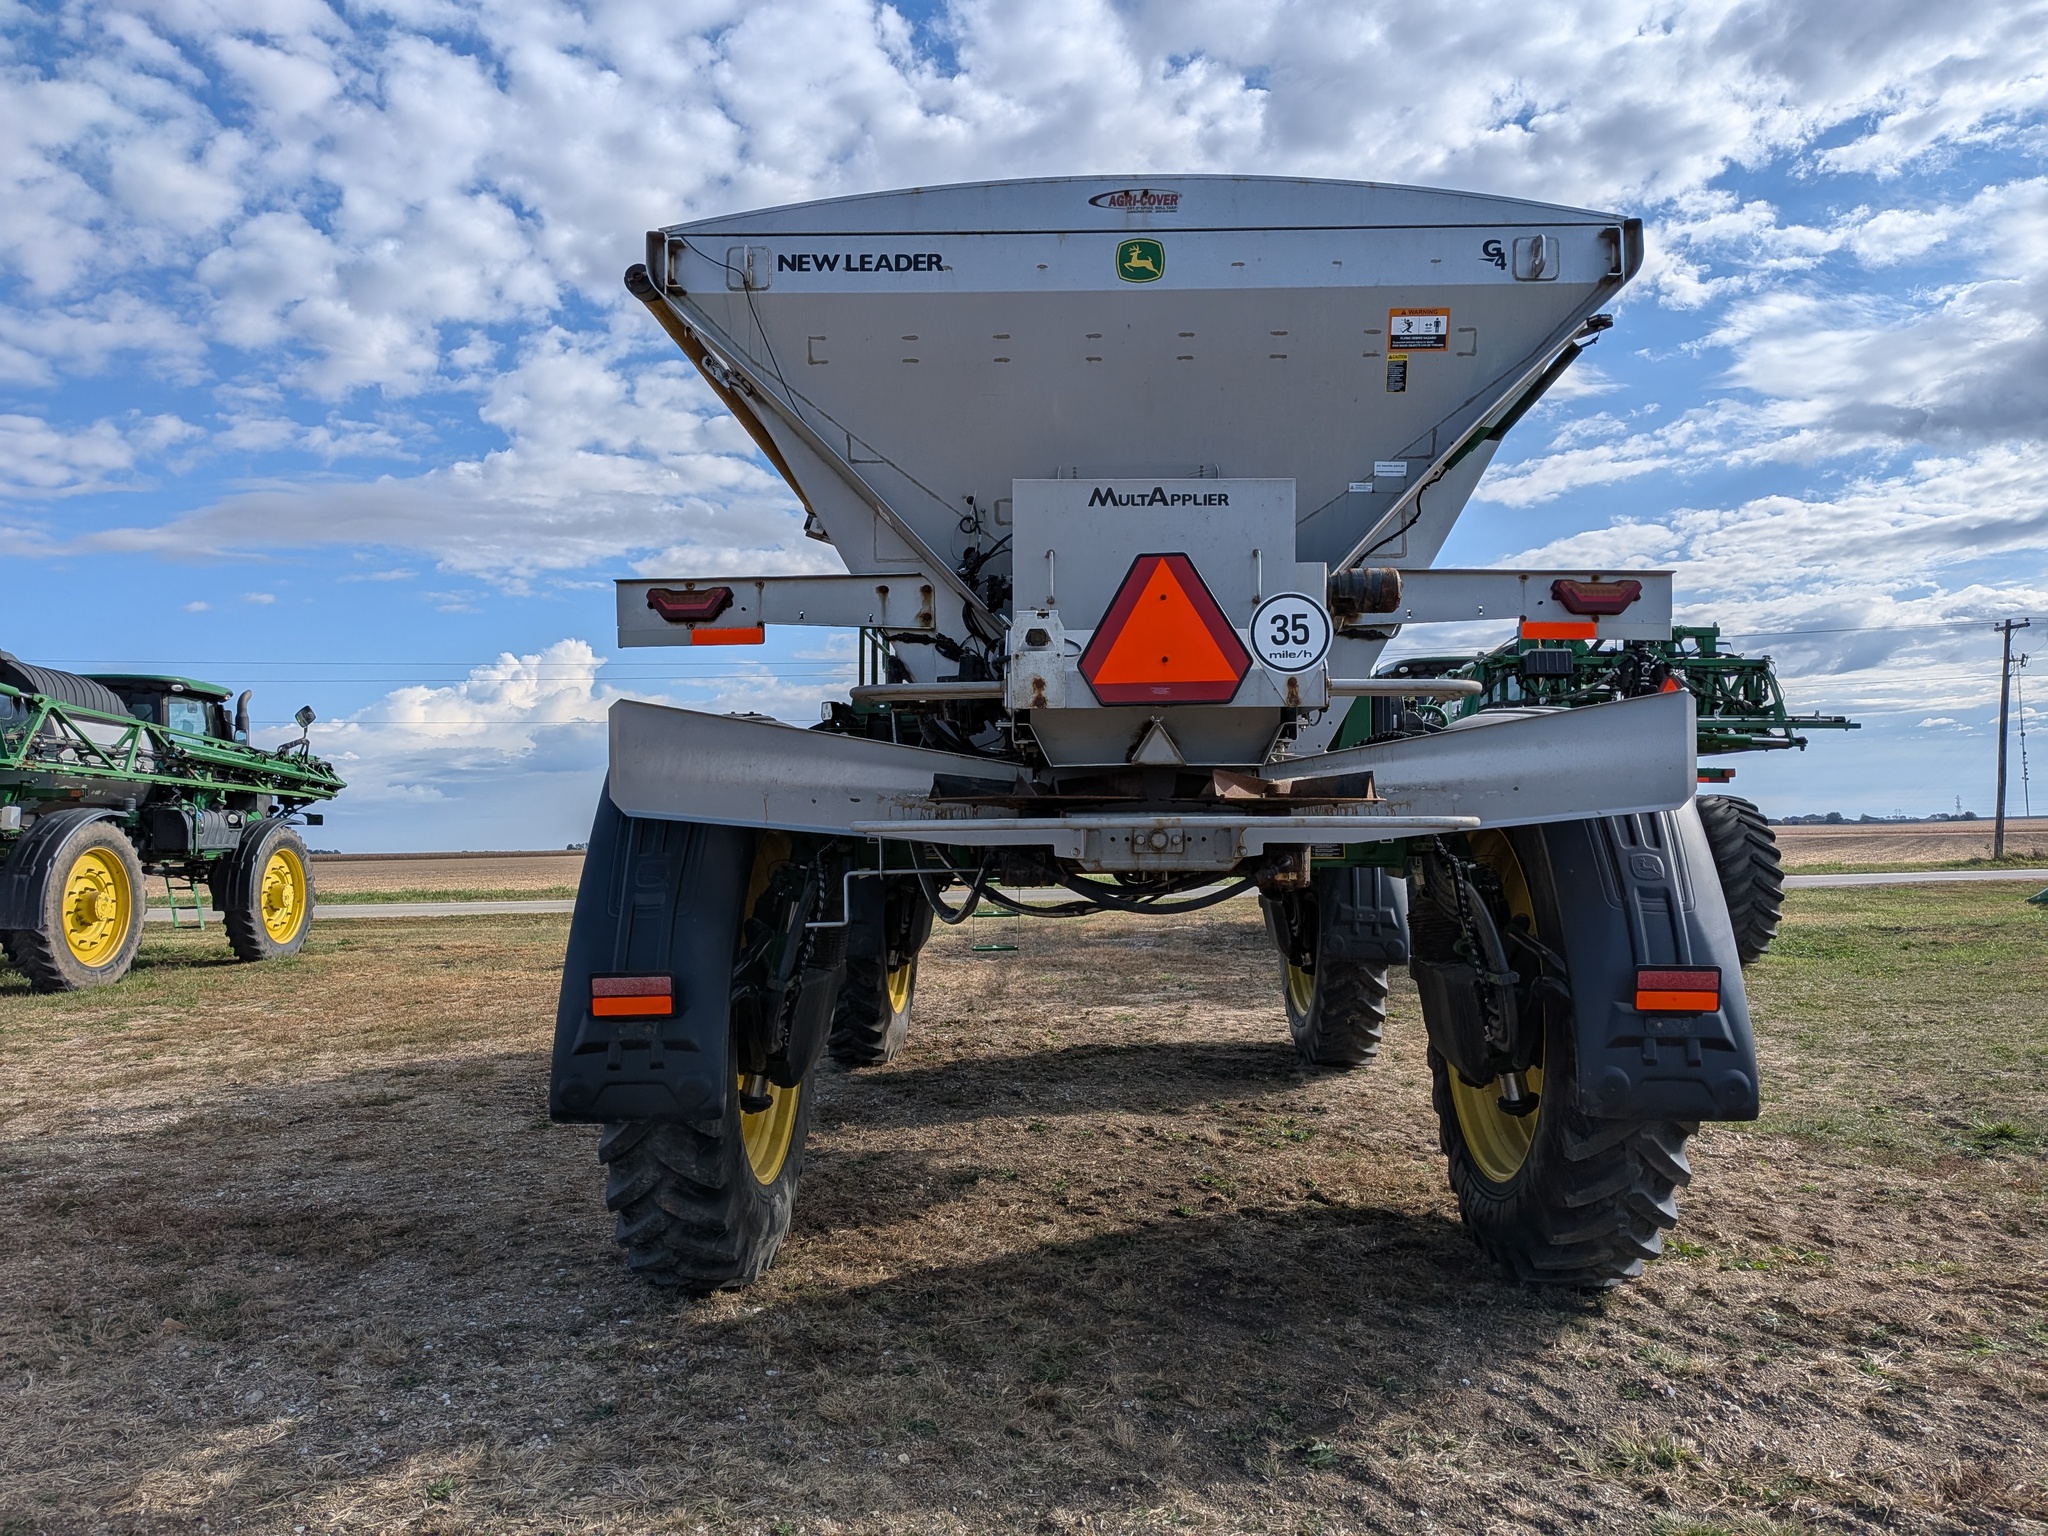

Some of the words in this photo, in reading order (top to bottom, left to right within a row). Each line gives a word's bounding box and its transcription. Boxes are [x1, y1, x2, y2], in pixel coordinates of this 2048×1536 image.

[778, 254, 840, 272] NEW
[845, 254, 944, 272] LEADER
[1270, 613, 1310, 645] 35
[1269, 650, 1312, 659] mile/h
